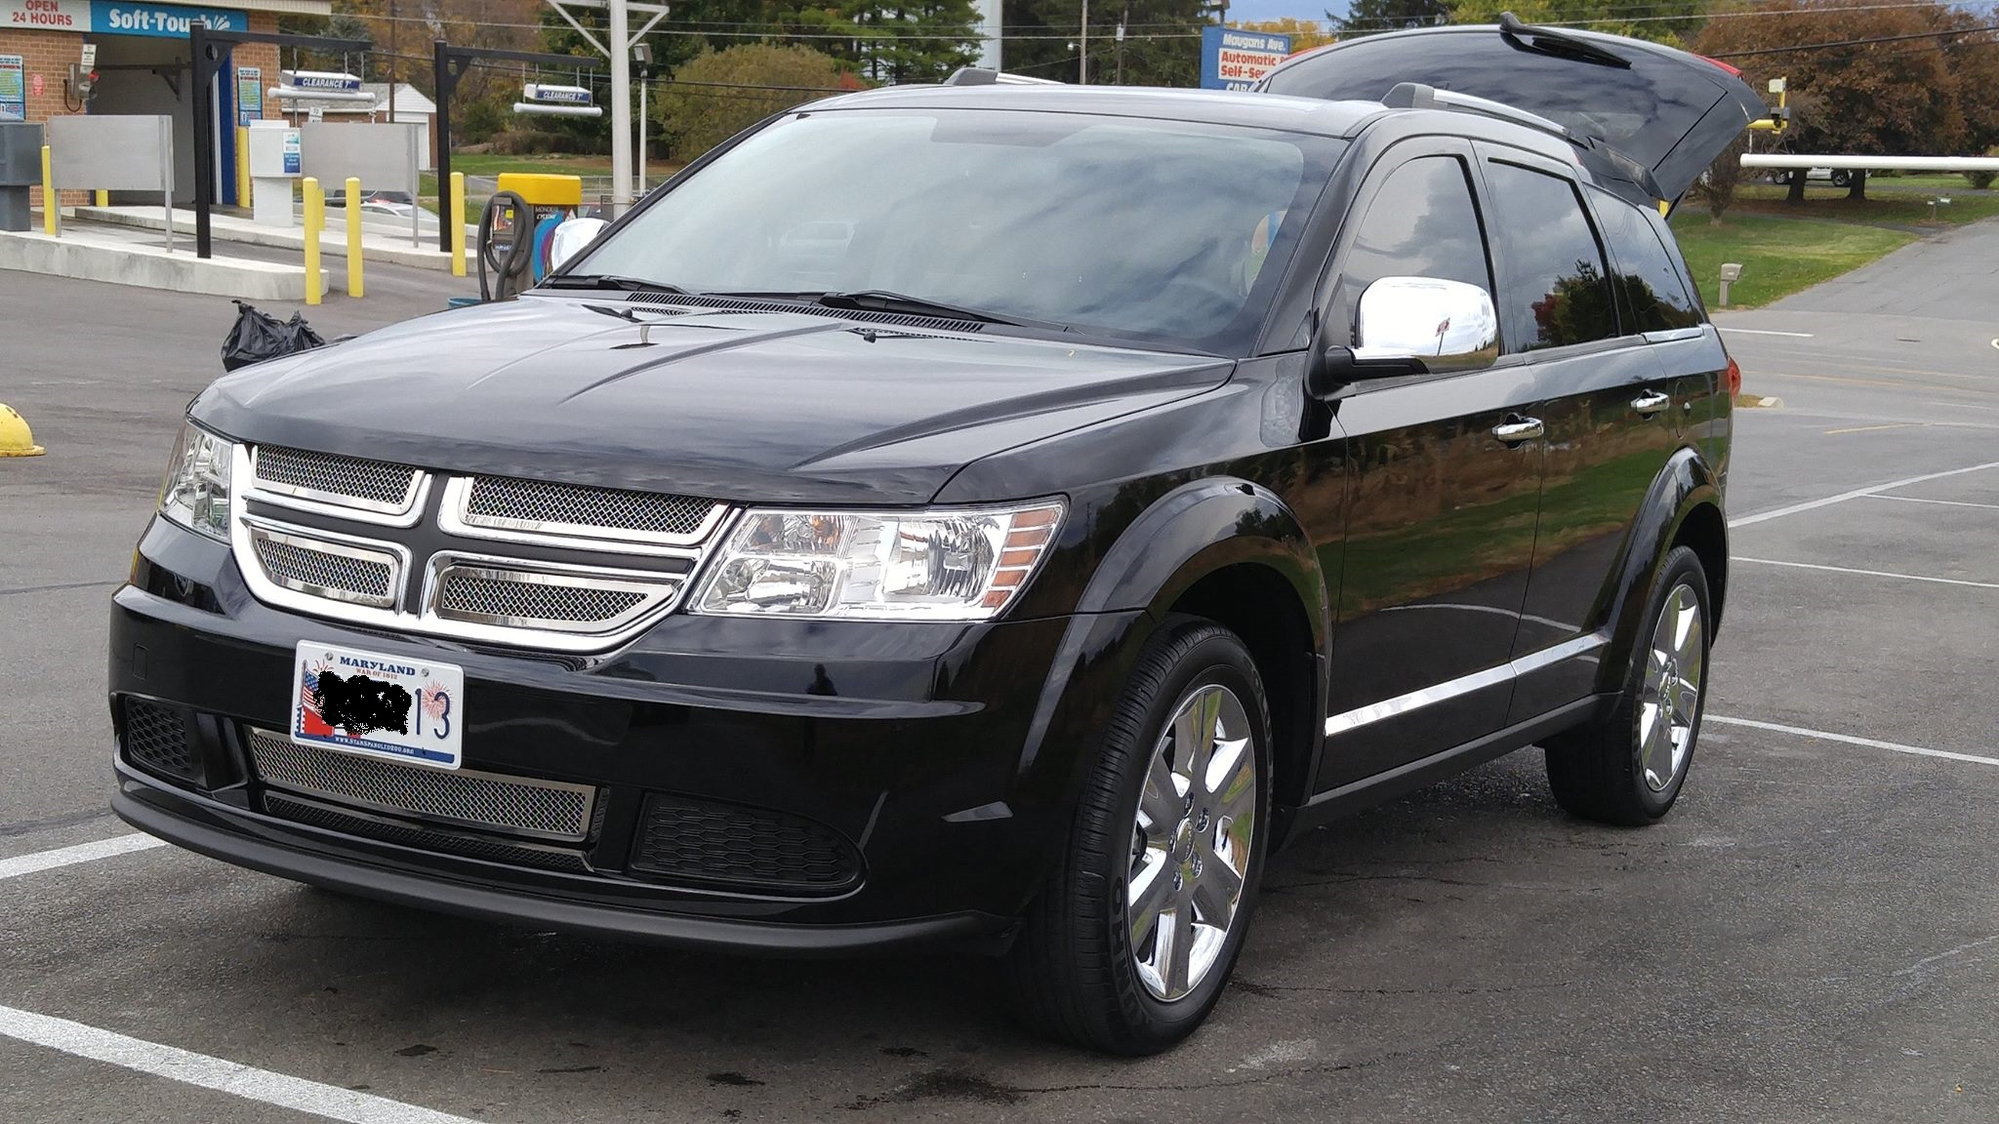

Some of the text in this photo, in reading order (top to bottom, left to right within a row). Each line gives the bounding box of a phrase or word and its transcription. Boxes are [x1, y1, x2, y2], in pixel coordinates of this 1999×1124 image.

[25, 0, 58, 12] OPEN
[12, 12, 73, 26] 24 HOURS
[109, 8, 212, 33] Soft-Touh
[1223, 33, 1286, 51] Maugans Ave.
[1221, 51, 1276, 66] Automatic
[1221, 65, 1266, 78] Self-Ser
[302, 78, 343, 88] CLEARANCE
[543, 91, 576, 101] CLEARANCE
[339, 656, 416, 676] MARYLAND
[382, 672, 398, 680] 1812
